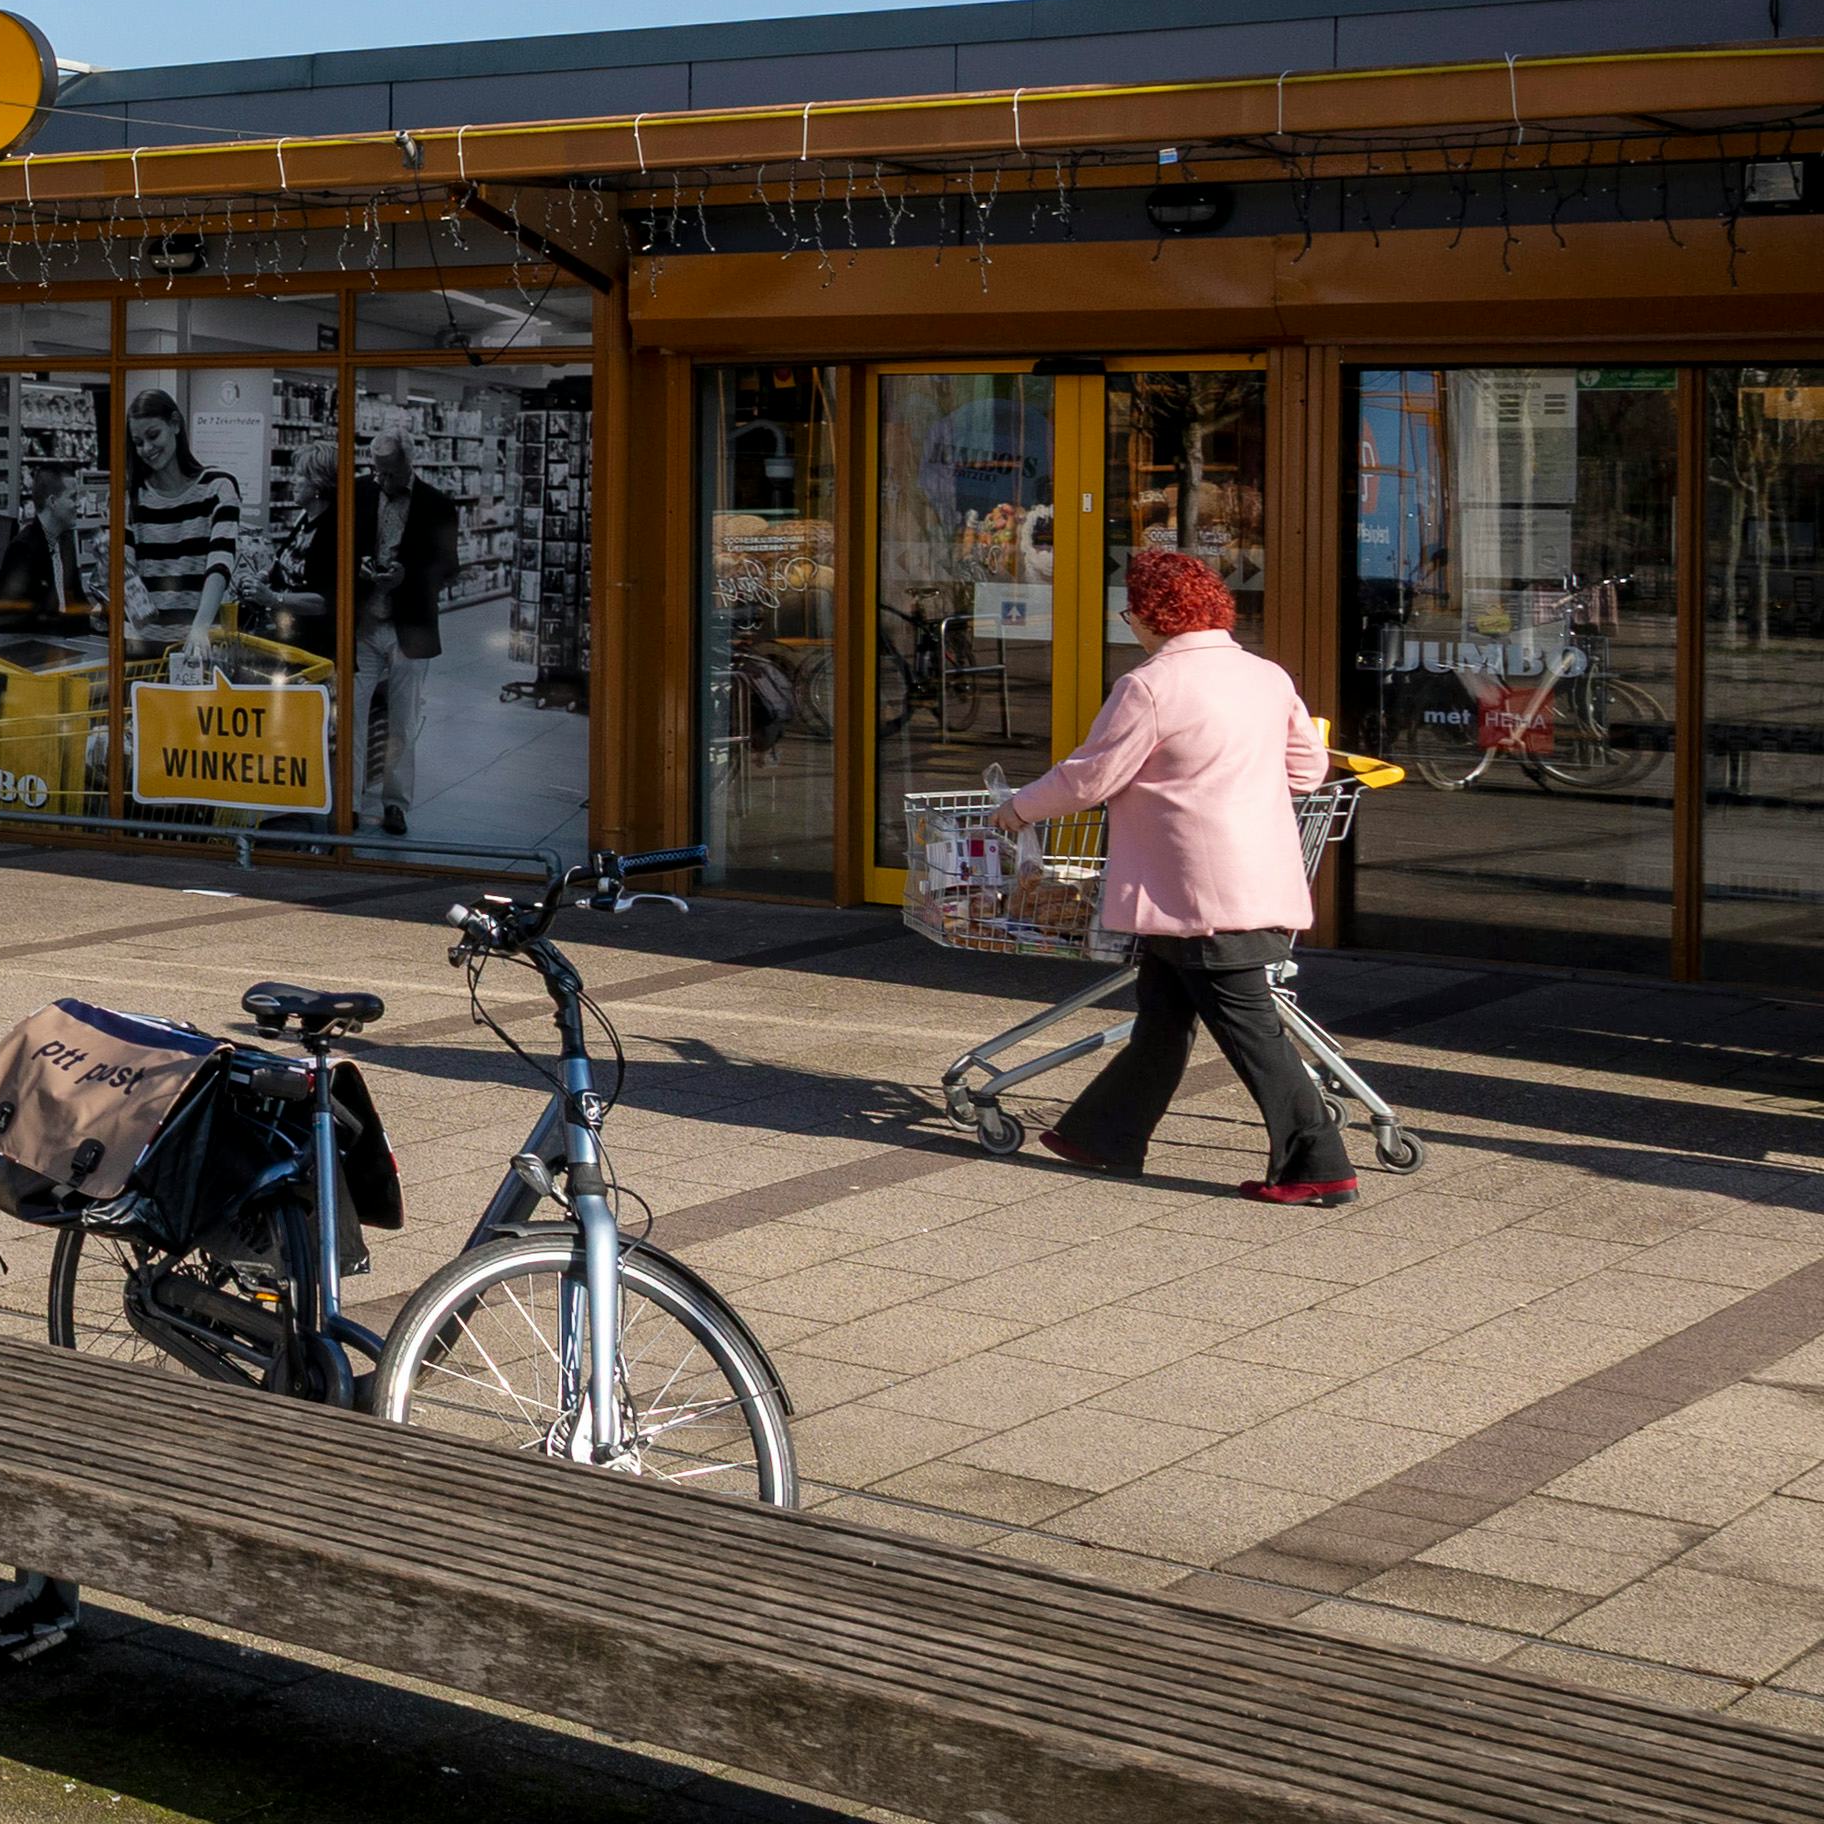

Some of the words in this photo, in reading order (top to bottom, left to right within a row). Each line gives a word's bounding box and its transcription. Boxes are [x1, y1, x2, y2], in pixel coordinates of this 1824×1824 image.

[1392, 640, 1588, 678] JUMBO
[197, 706, 266, 738] VLOT
[1423, 706, 1472, 725] met
[1484, 712, 1546, 728] HEMA
[162, 747, 307, 787] WINKELEN
[31, 1040, 89, 1071] ptt
[74, 1063, 146, 1095] post
